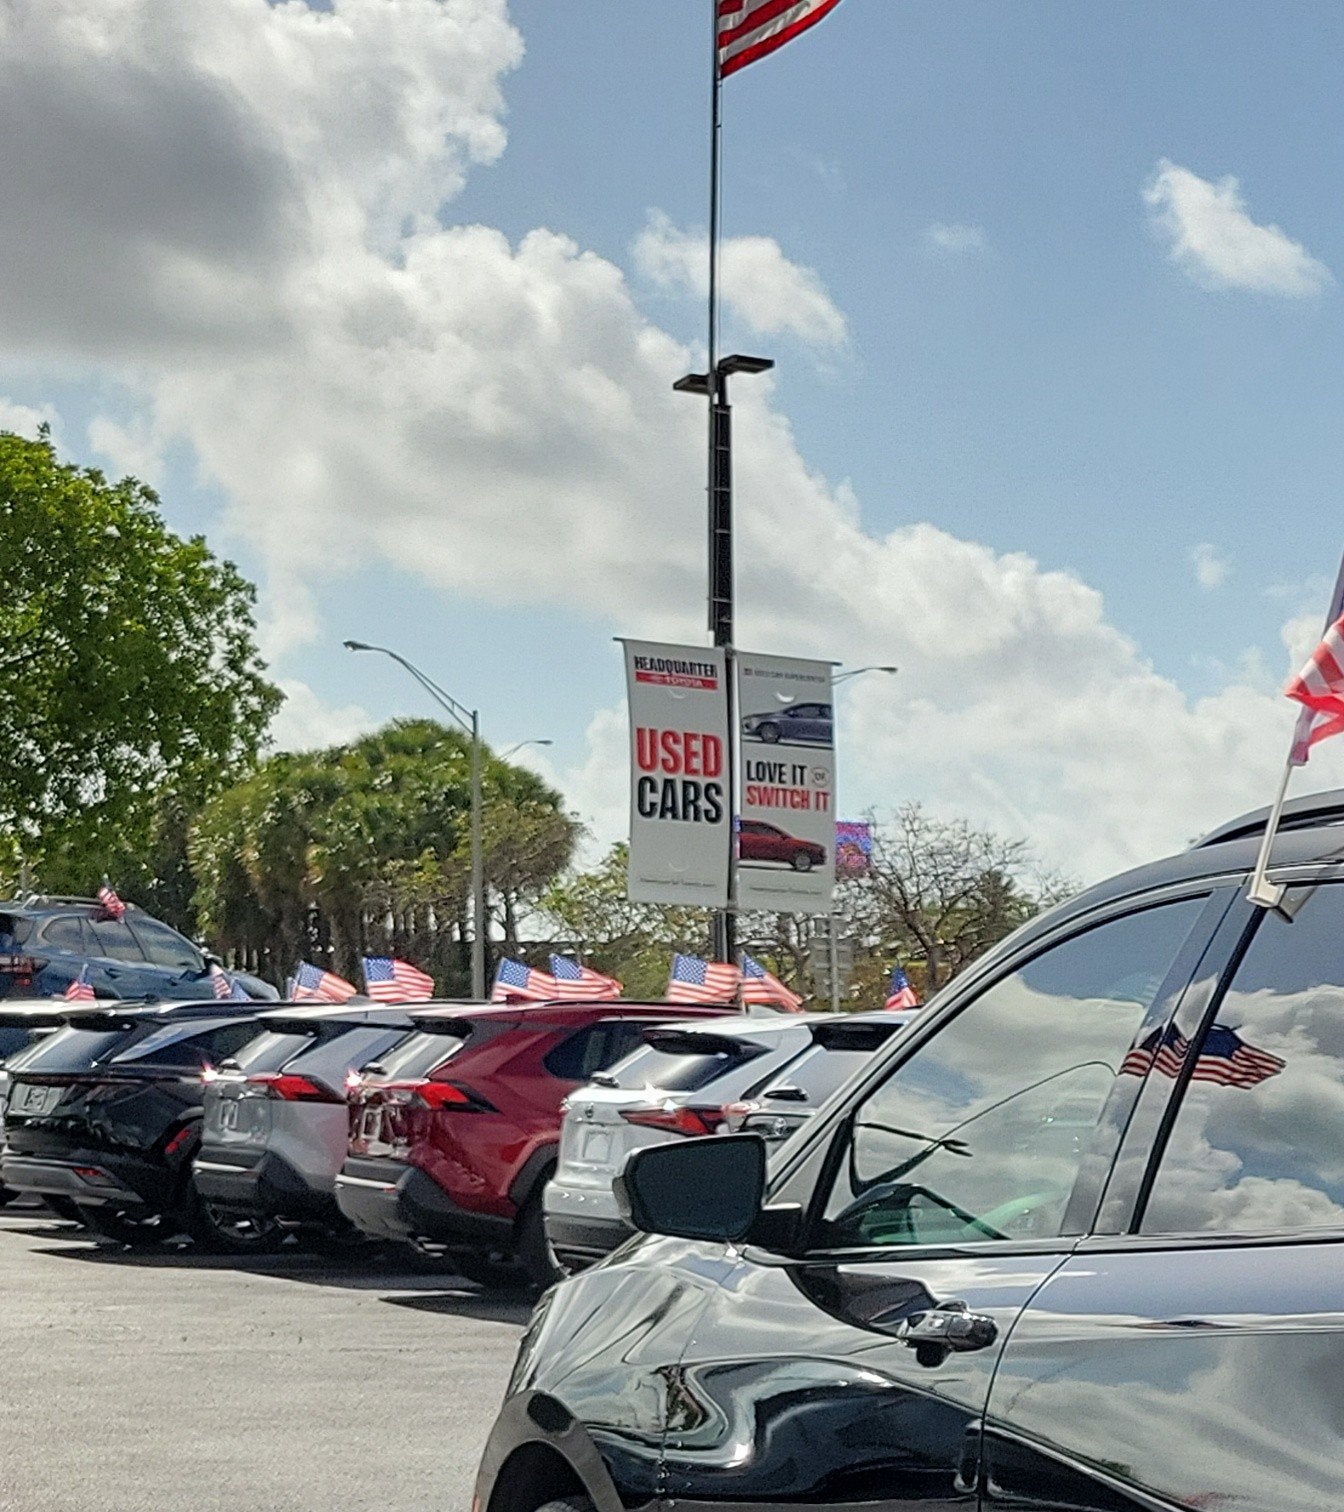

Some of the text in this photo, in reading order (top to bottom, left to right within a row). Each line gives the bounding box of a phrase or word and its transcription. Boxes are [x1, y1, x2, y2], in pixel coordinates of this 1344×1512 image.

[633, 655, 718, 679] HEADQUARTER
[636, 727, 723, 778] USED
[746, 760, 807, 785] LOVE IT
[637, 776, 723, 824] CARS
[746, 785, 831, 812] SWITCH IT
